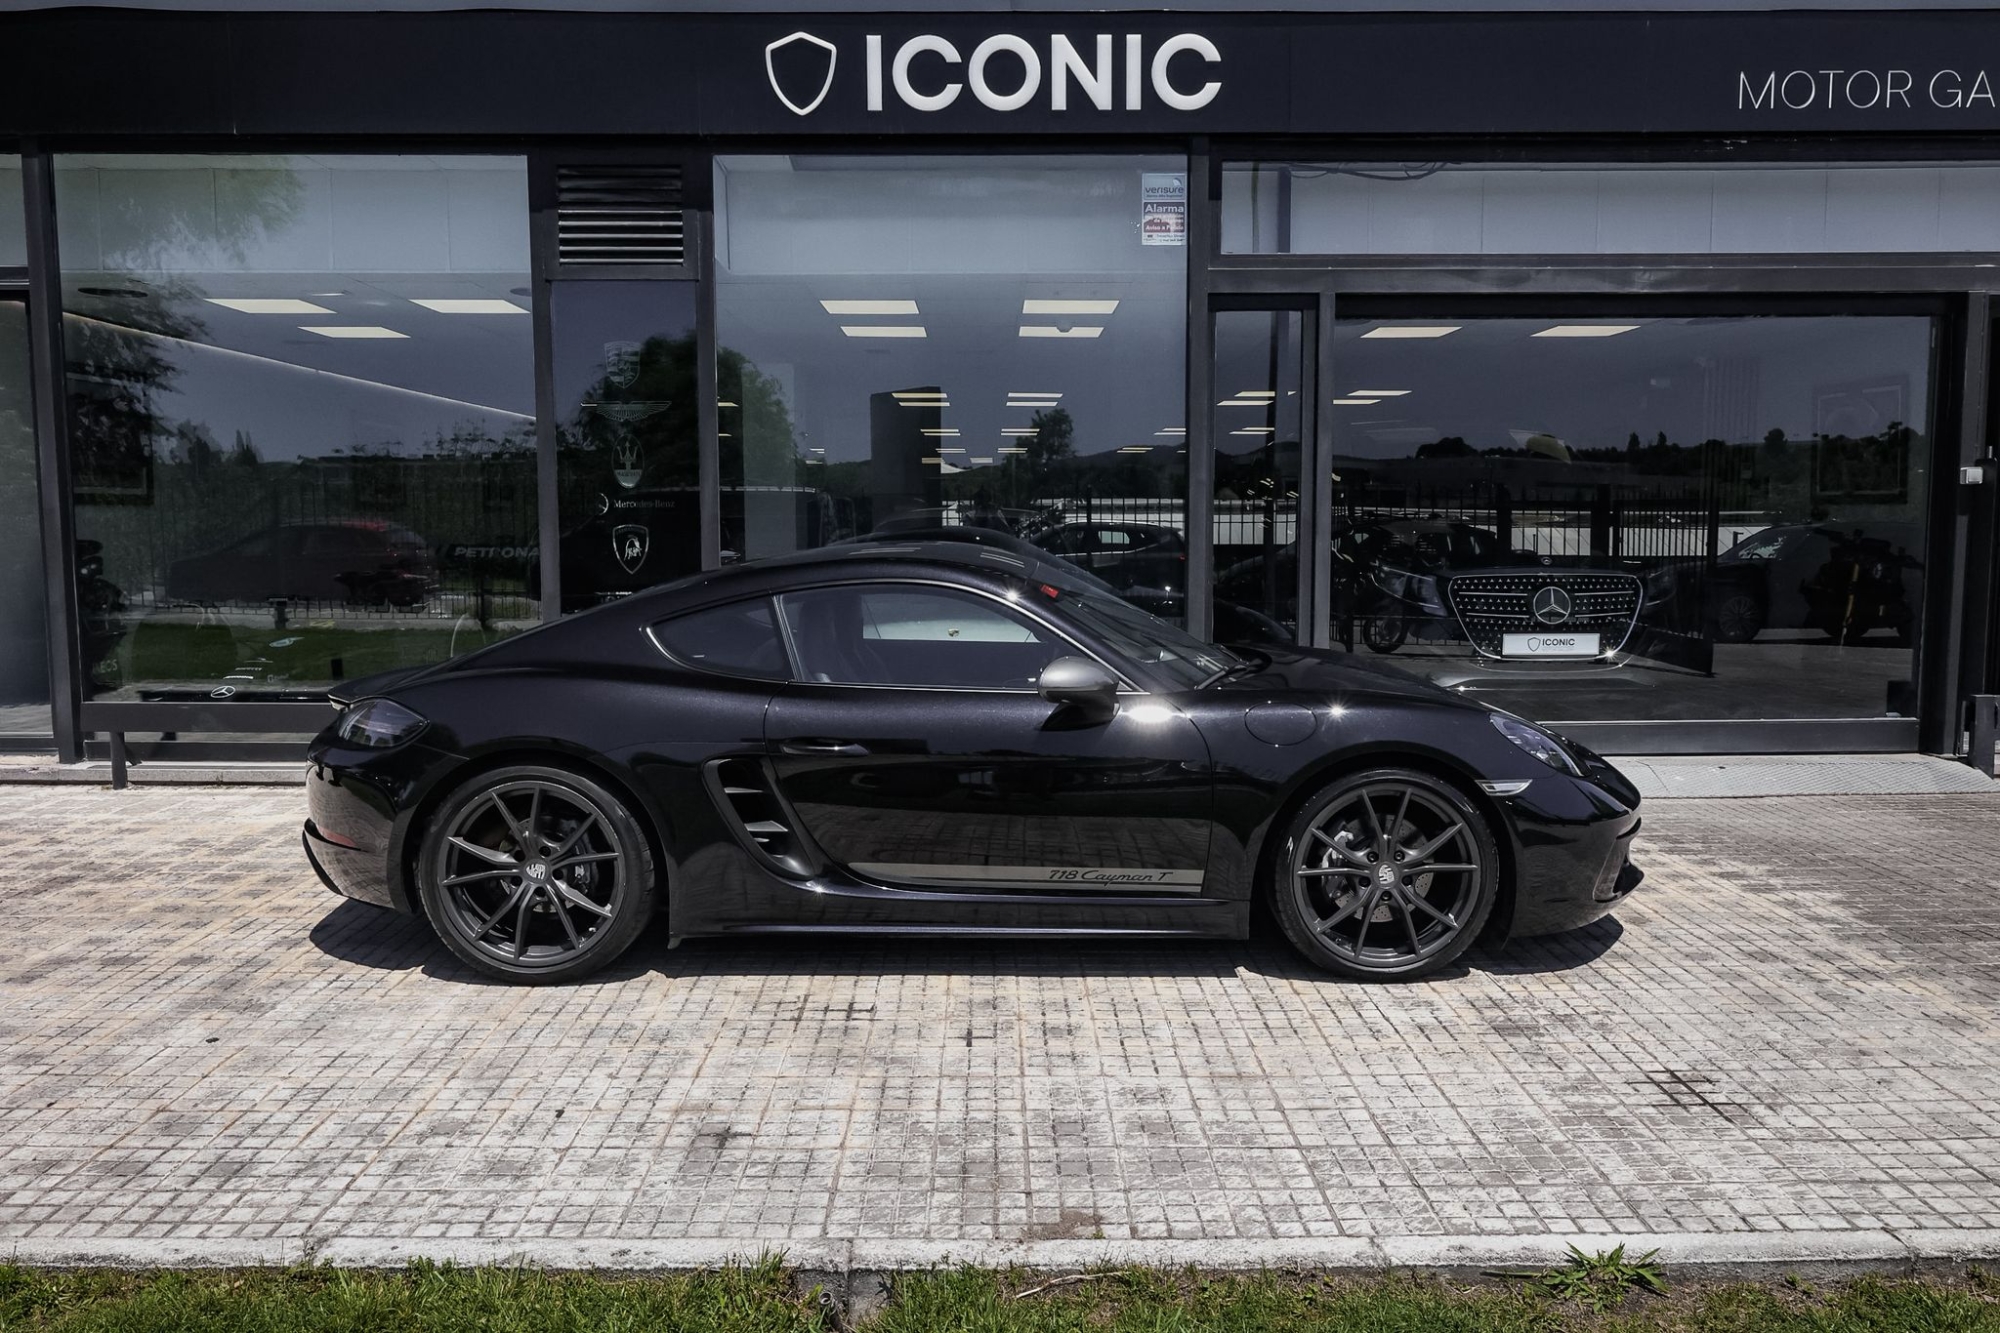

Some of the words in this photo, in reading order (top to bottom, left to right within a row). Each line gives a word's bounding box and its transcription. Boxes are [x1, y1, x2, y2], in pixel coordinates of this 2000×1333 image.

[866, 33, 1222, 111] ICONIC
[1739, 70, 1912, 109] MOTOR
[1929, 69, 1996, 108] GA
[1145, 203, 1184, 213] Alarma
[1542, 638, 1576, 646] ICONIC
[1049, 870, 1079, 880] 718
[1081, 869, 1153, 887] Cayman
[1158, 871, 1174, 881] T
